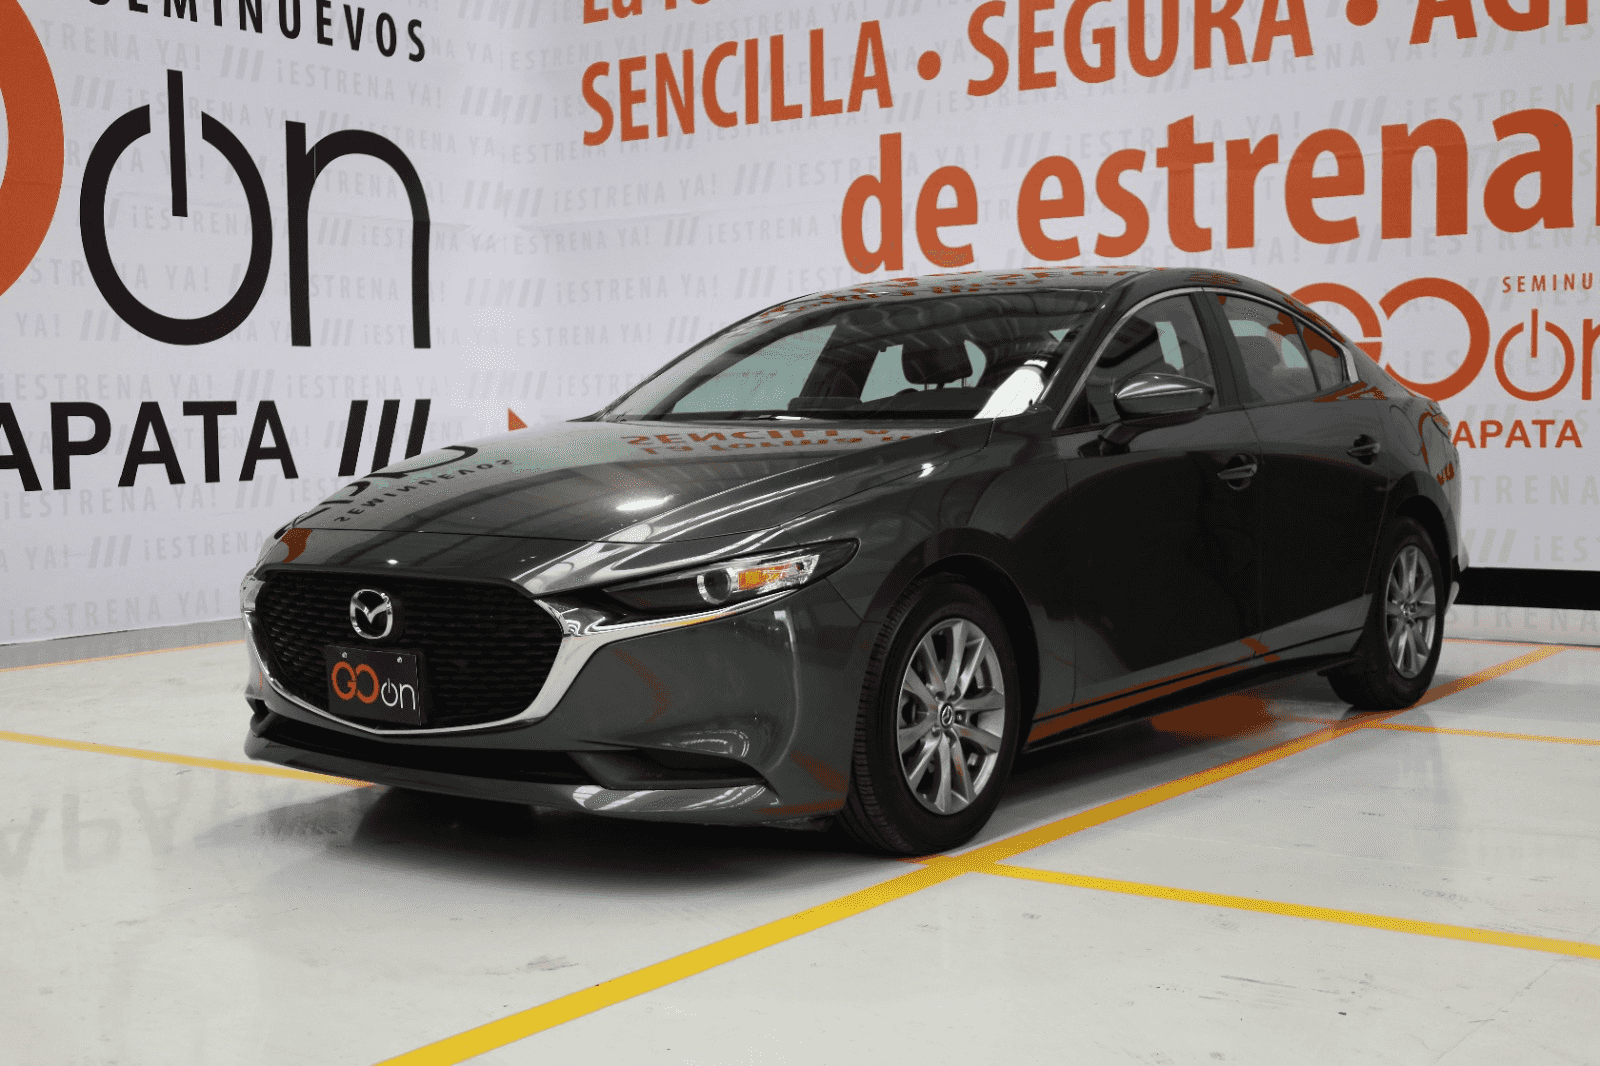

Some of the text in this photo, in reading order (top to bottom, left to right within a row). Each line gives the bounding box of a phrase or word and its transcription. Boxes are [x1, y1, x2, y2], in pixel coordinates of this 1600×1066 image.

[581, 19, 893, 147] SENCILLA
[966, 0, 1314, 97] SEGURA
[679, 171, 718, 202] YA!
[841, 103, 1600, 274] de estrena
[681, 273, 719, 299] YA!
[1502, 272, 1593, 293] SEMINU
[15, 312, 61, 338] YA!
[169, 373, 214, 401] YA!
[1453, 419, 1583, 448] APATA
